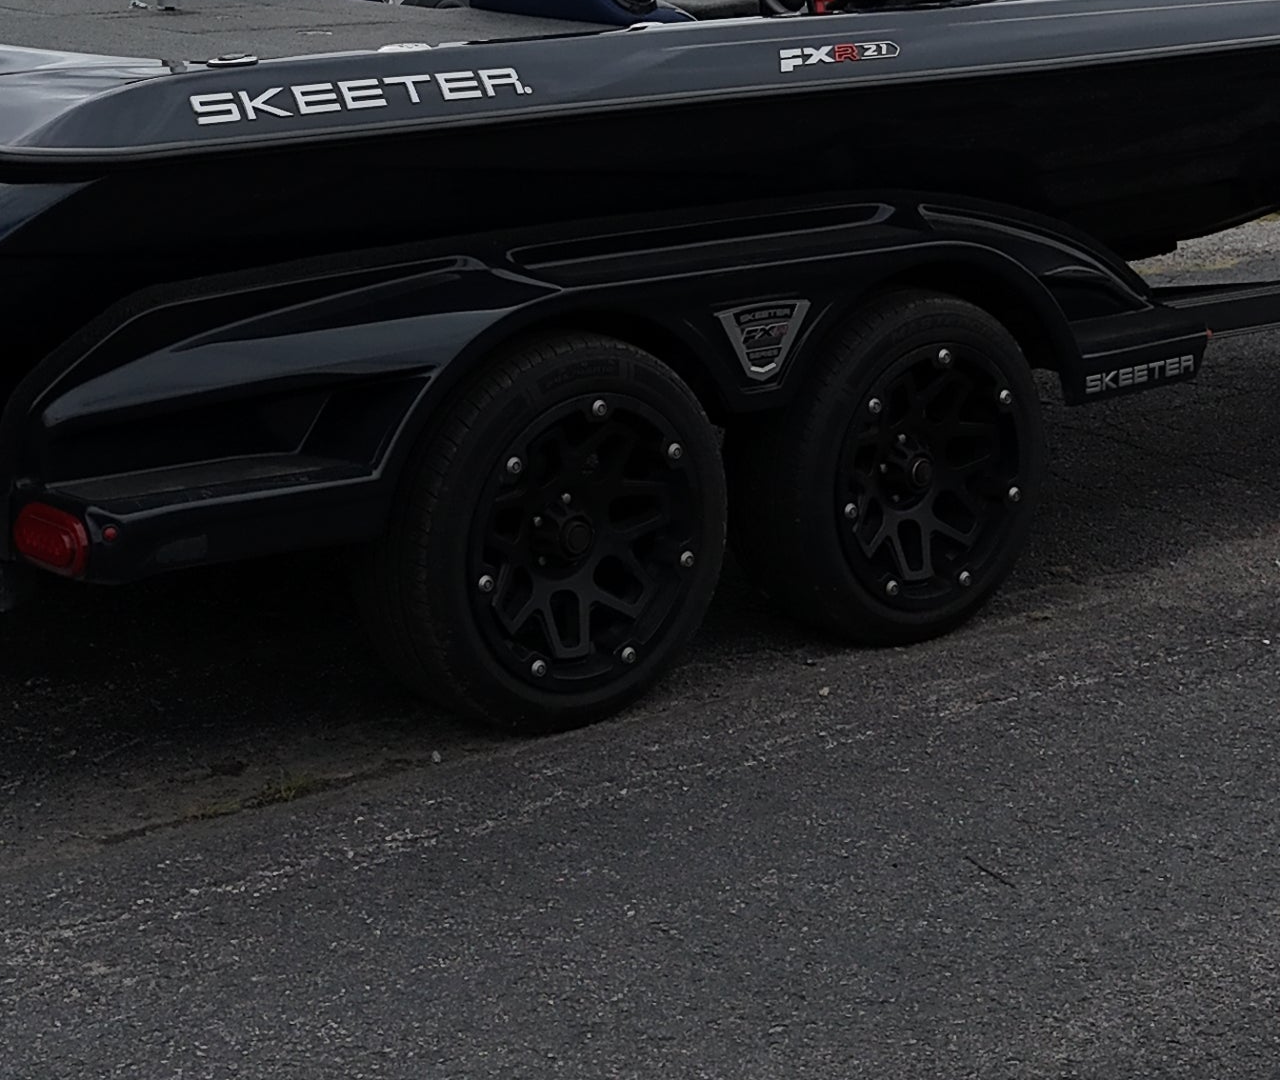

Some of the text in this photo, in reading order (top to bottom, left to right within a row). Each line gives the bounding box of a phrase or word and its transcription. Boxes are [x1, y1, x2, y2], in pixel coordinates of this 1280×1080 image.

[780, 43, 888, 73] FXR 21
[1084, 354, 1196, 395] SKEETER
